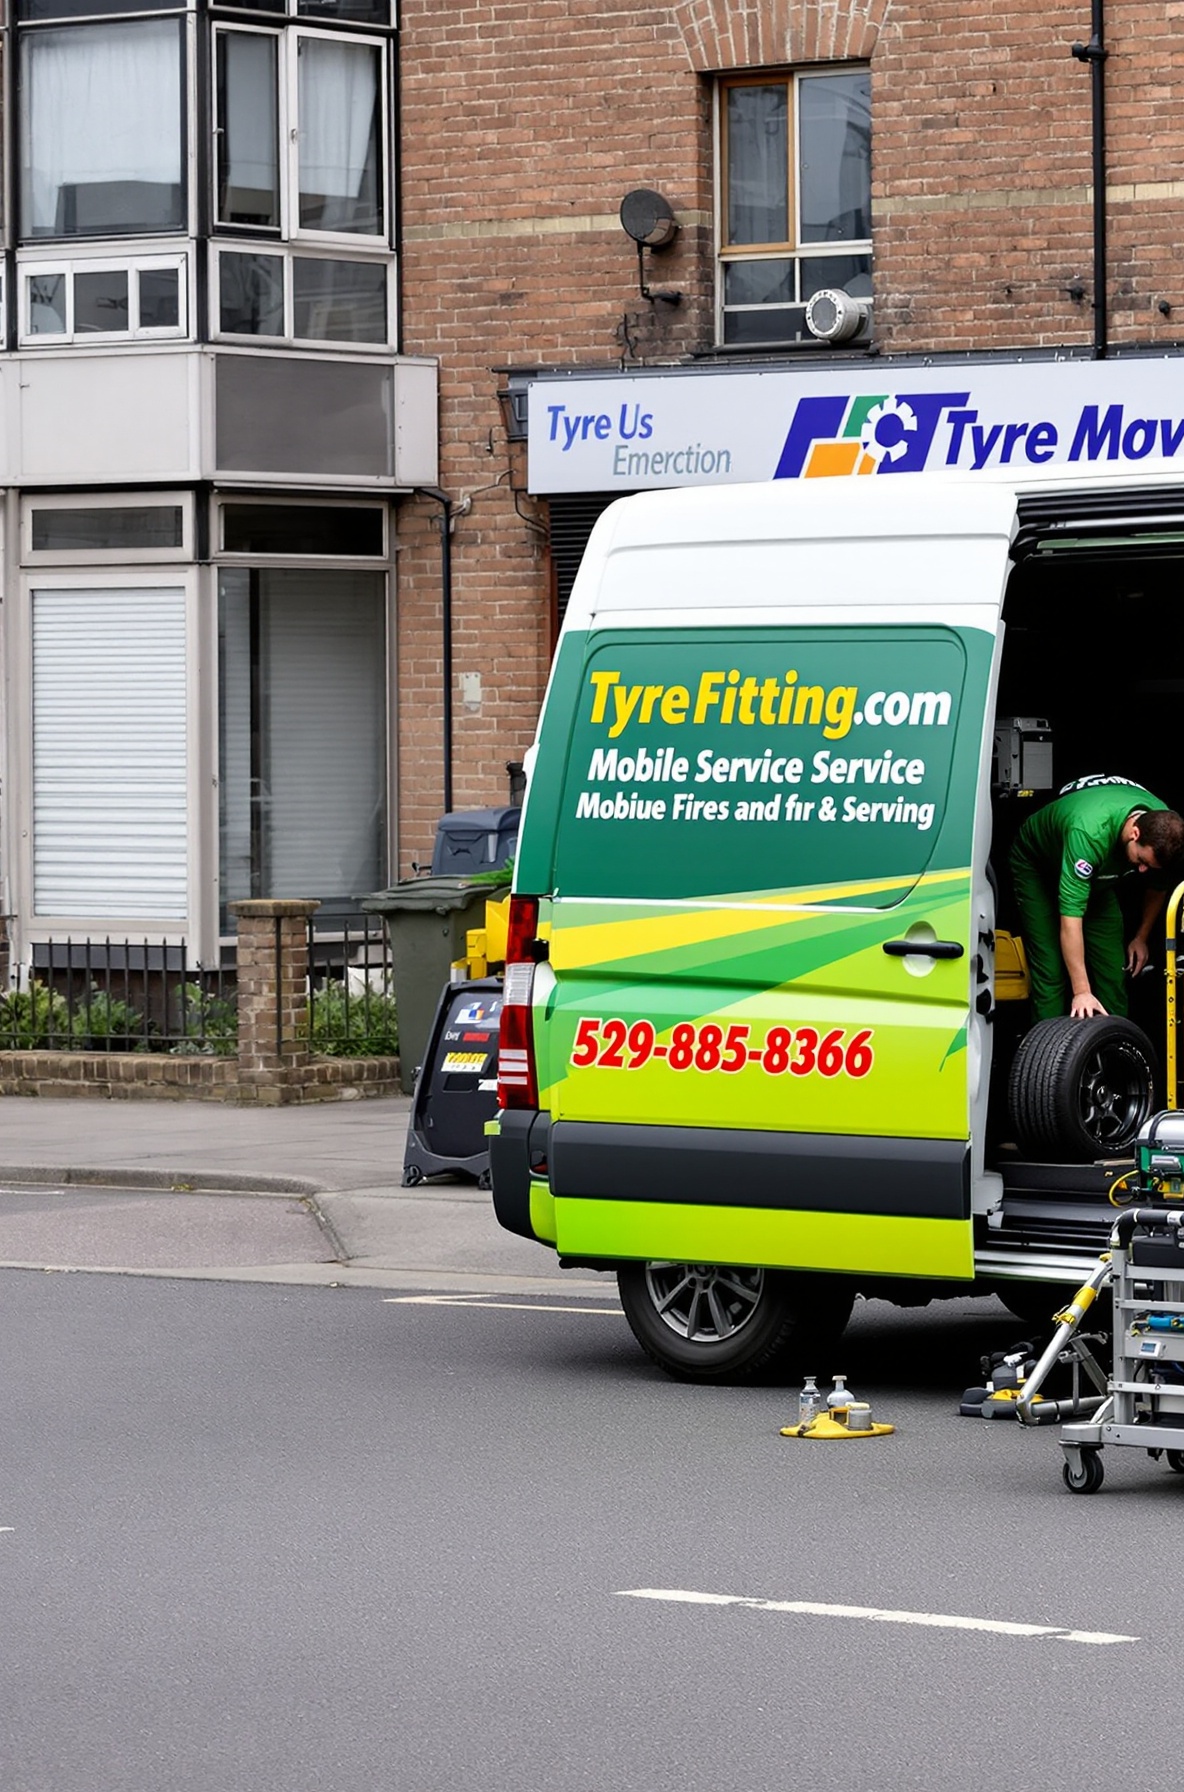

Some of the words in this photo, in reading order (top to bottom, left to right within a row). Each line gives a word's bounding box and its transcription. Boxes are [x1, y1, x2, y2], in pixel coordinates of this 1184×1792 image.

[547, 405, 612, 452] Tyre
[618, 404, 654, 440] Us
[945, 409, 1058, 470] Tyre
[612, 443, 732, 476] Emerction
[587, 747, 689, 783] Mobile
[694, 748, 803, 784] Service
[811, 750, 925, 784] Service
[575, 792, 666, 821] Mobiue
[672, 793, 730, 822] Fires
[734, 793, 778, 822] and
[818, 796, 837, 822] &
[842, 796, 936, 832] Serving
[569, 1016, 876, 1079] 529-885-8366
